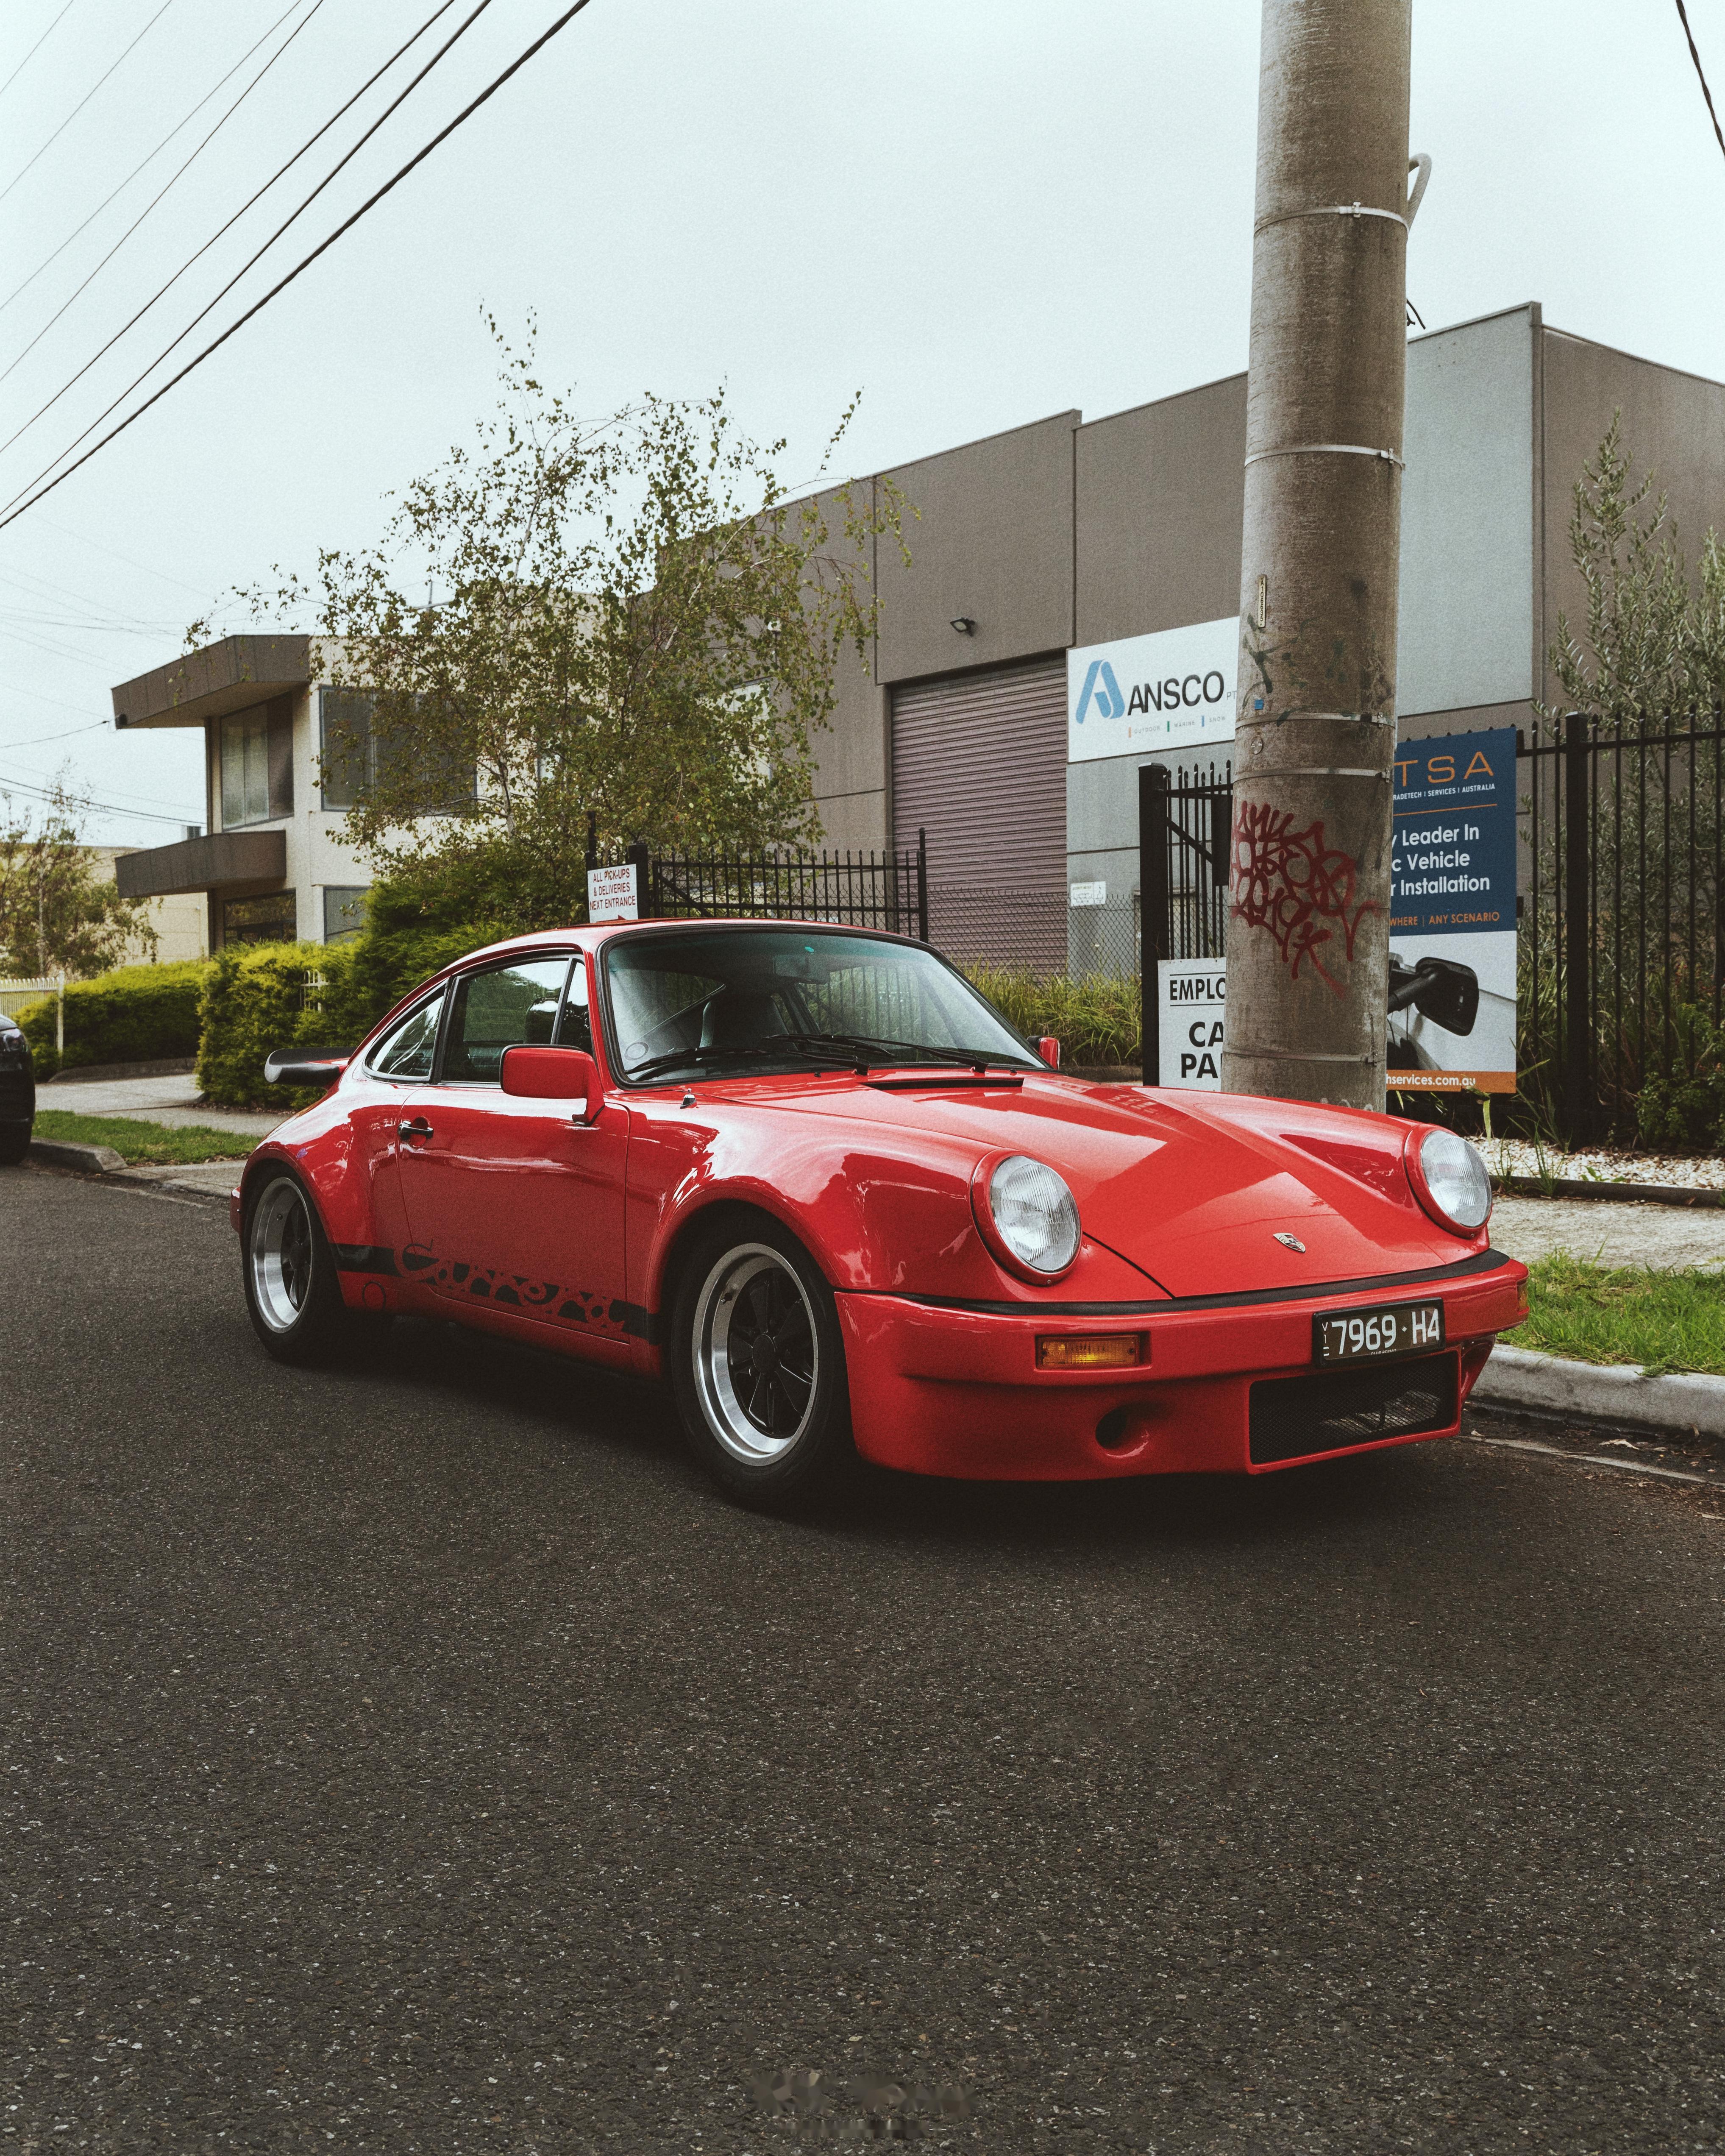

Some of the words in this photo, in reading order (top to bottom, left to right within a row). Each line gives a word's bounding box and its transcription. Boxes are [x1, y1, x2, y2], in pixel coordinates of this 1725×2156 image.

[1127, 671, 1224, 716] ANSCO
[1134, 725, 1160, 734] OUTDOOR
[1427, 787, 1456, 797] SERVICES
[1462, 783, 1495, 793] AUSTRALIA
[1402, 826, 1459, 846] Leader
[1464, 824, 1479, 841] In
[1407, 850, 1470, 870] Vehicle
[593, 872, 603, 883] ALL
[604, 868, 630, 881] PICK-UPS
[594, 887, 597, 896] &
[598, 882, 630, 896] DELIVERIES
[1401, 874, 1490, 896] Installation
[590, 900, 603, 910] NEXT
[605, 895, 636, 908] ENTRANCE
[1429, 914, 1448, 925] ANY
[1451, 911, 1500, 924] SCENARIO
[1181, 1053, 1222, 1078] PA
[1331, 1315, 1396, 1355] 7969
